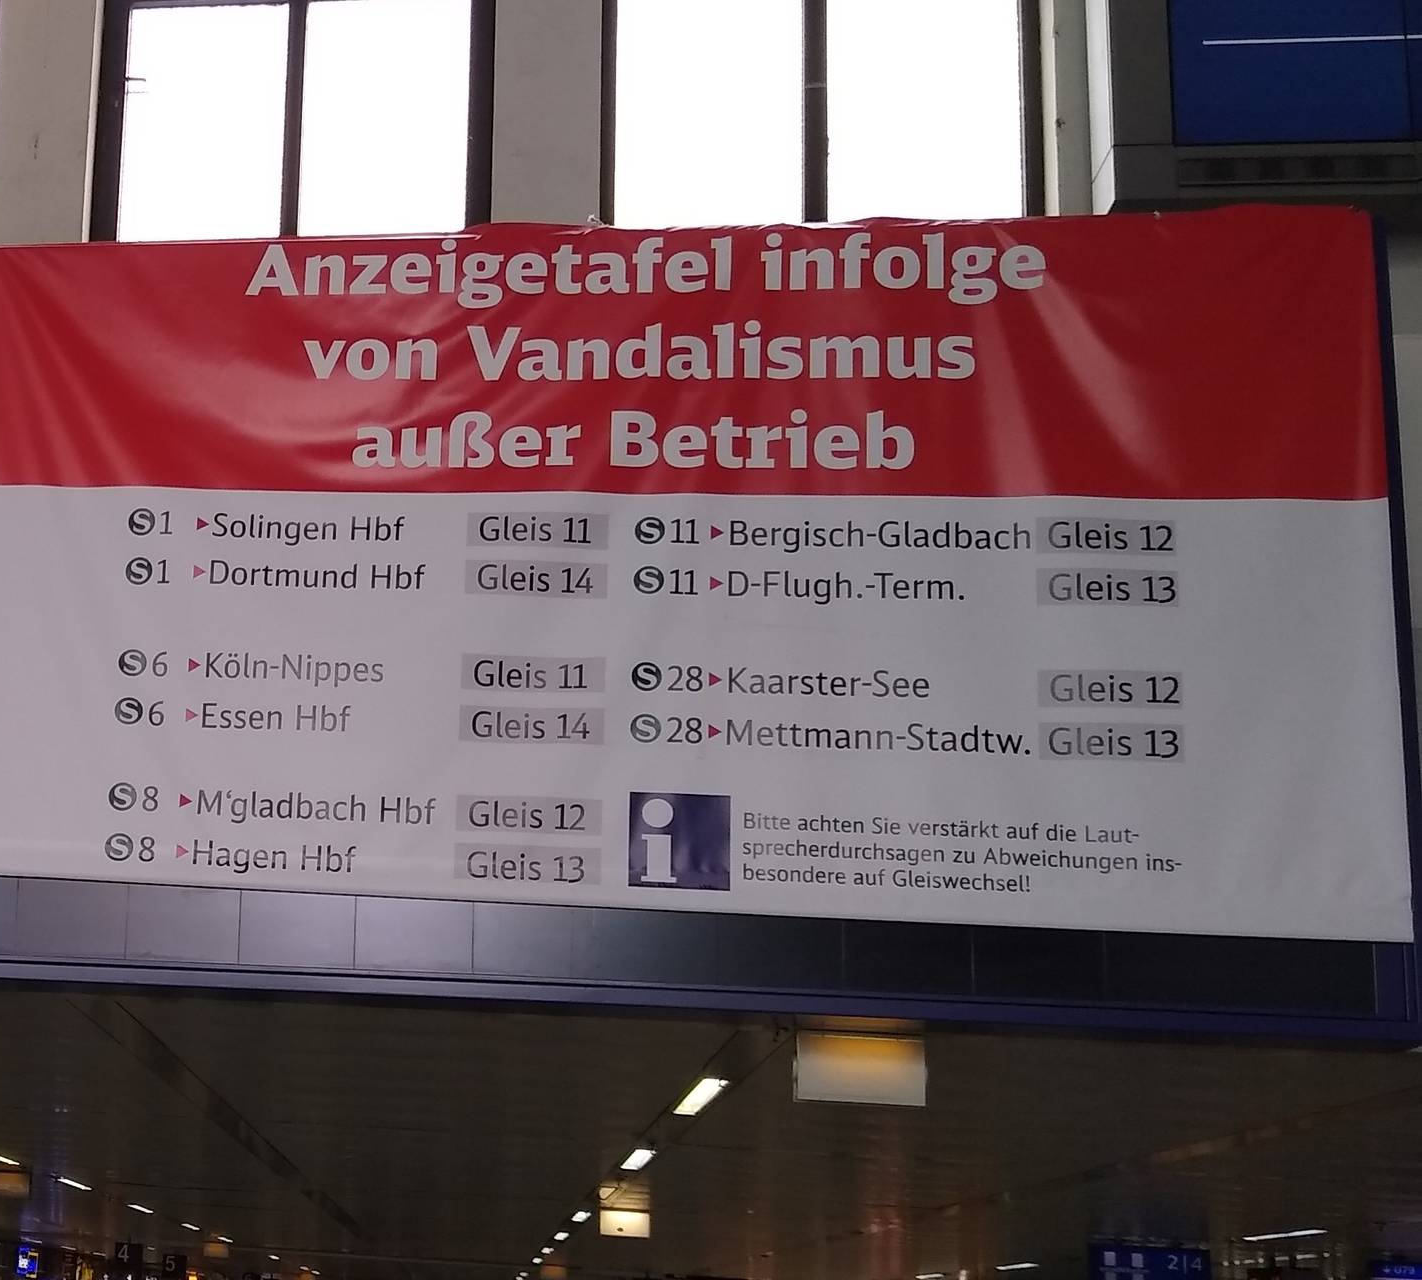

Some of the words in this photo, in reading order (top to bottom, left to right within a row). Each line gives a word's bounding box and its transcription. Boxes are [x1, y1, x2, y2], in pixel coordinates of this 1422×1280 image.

[244, 233, 732, 309] Anzeigetafel
[760, 232, 1047, 306] infolge
[303, 339, 439, 382] von
[466, 321, 977, 382] Vandalismus
[351, 410, 582, 469] außer
[609, 408, 916, 469] Betrieb
[211, 512, 337, 547] Solingen
[350, 516, 406, 542] Hbf
[479, 515, 552, 542] Gleis
[563, 517, 592, 544] 11
[729, 520, 1031, 554] Bergisch-Gladbach
[209, 559, 358, 589] Dortmund
[371, 563, 426, 590] Hbf
[477, 563, 550, 593] Gleis
[561, 567, 594, 594] 14
[205, 652, 384, 688] Köln-Nippes
[728, 666, 930, 699] Kaarster-See
[726, 719, 1031, 756] Mettmann-Stadtw.
[380, 796, 437, 825] Hbf
[468, 800, 543, 829] Gleis
[554, 803, 585, 831] 12
[743, 811, 791, 831] Bitte
[797, 814, 865, 834] achten
[871, 816, 901, 836] Sie
[908, 820, 1000, 839] verstärkt
[1006, 822, 1039, 841] auf
[1045, 823, 1077, 843] die
[742, 838, 945, 867] sprecherdurchsagen
[952, 850, 975, 864] zu
[983, 847, 1138, 875] Abweichungen
[742, 862, 846, 885] besondere
[853, 868, 886, 886] auf
[892, 869, 1031, 893] Gleiswechsel!
[117, 1243, 130, 1263] 4
[164, 1255, 177, 1273] 5
